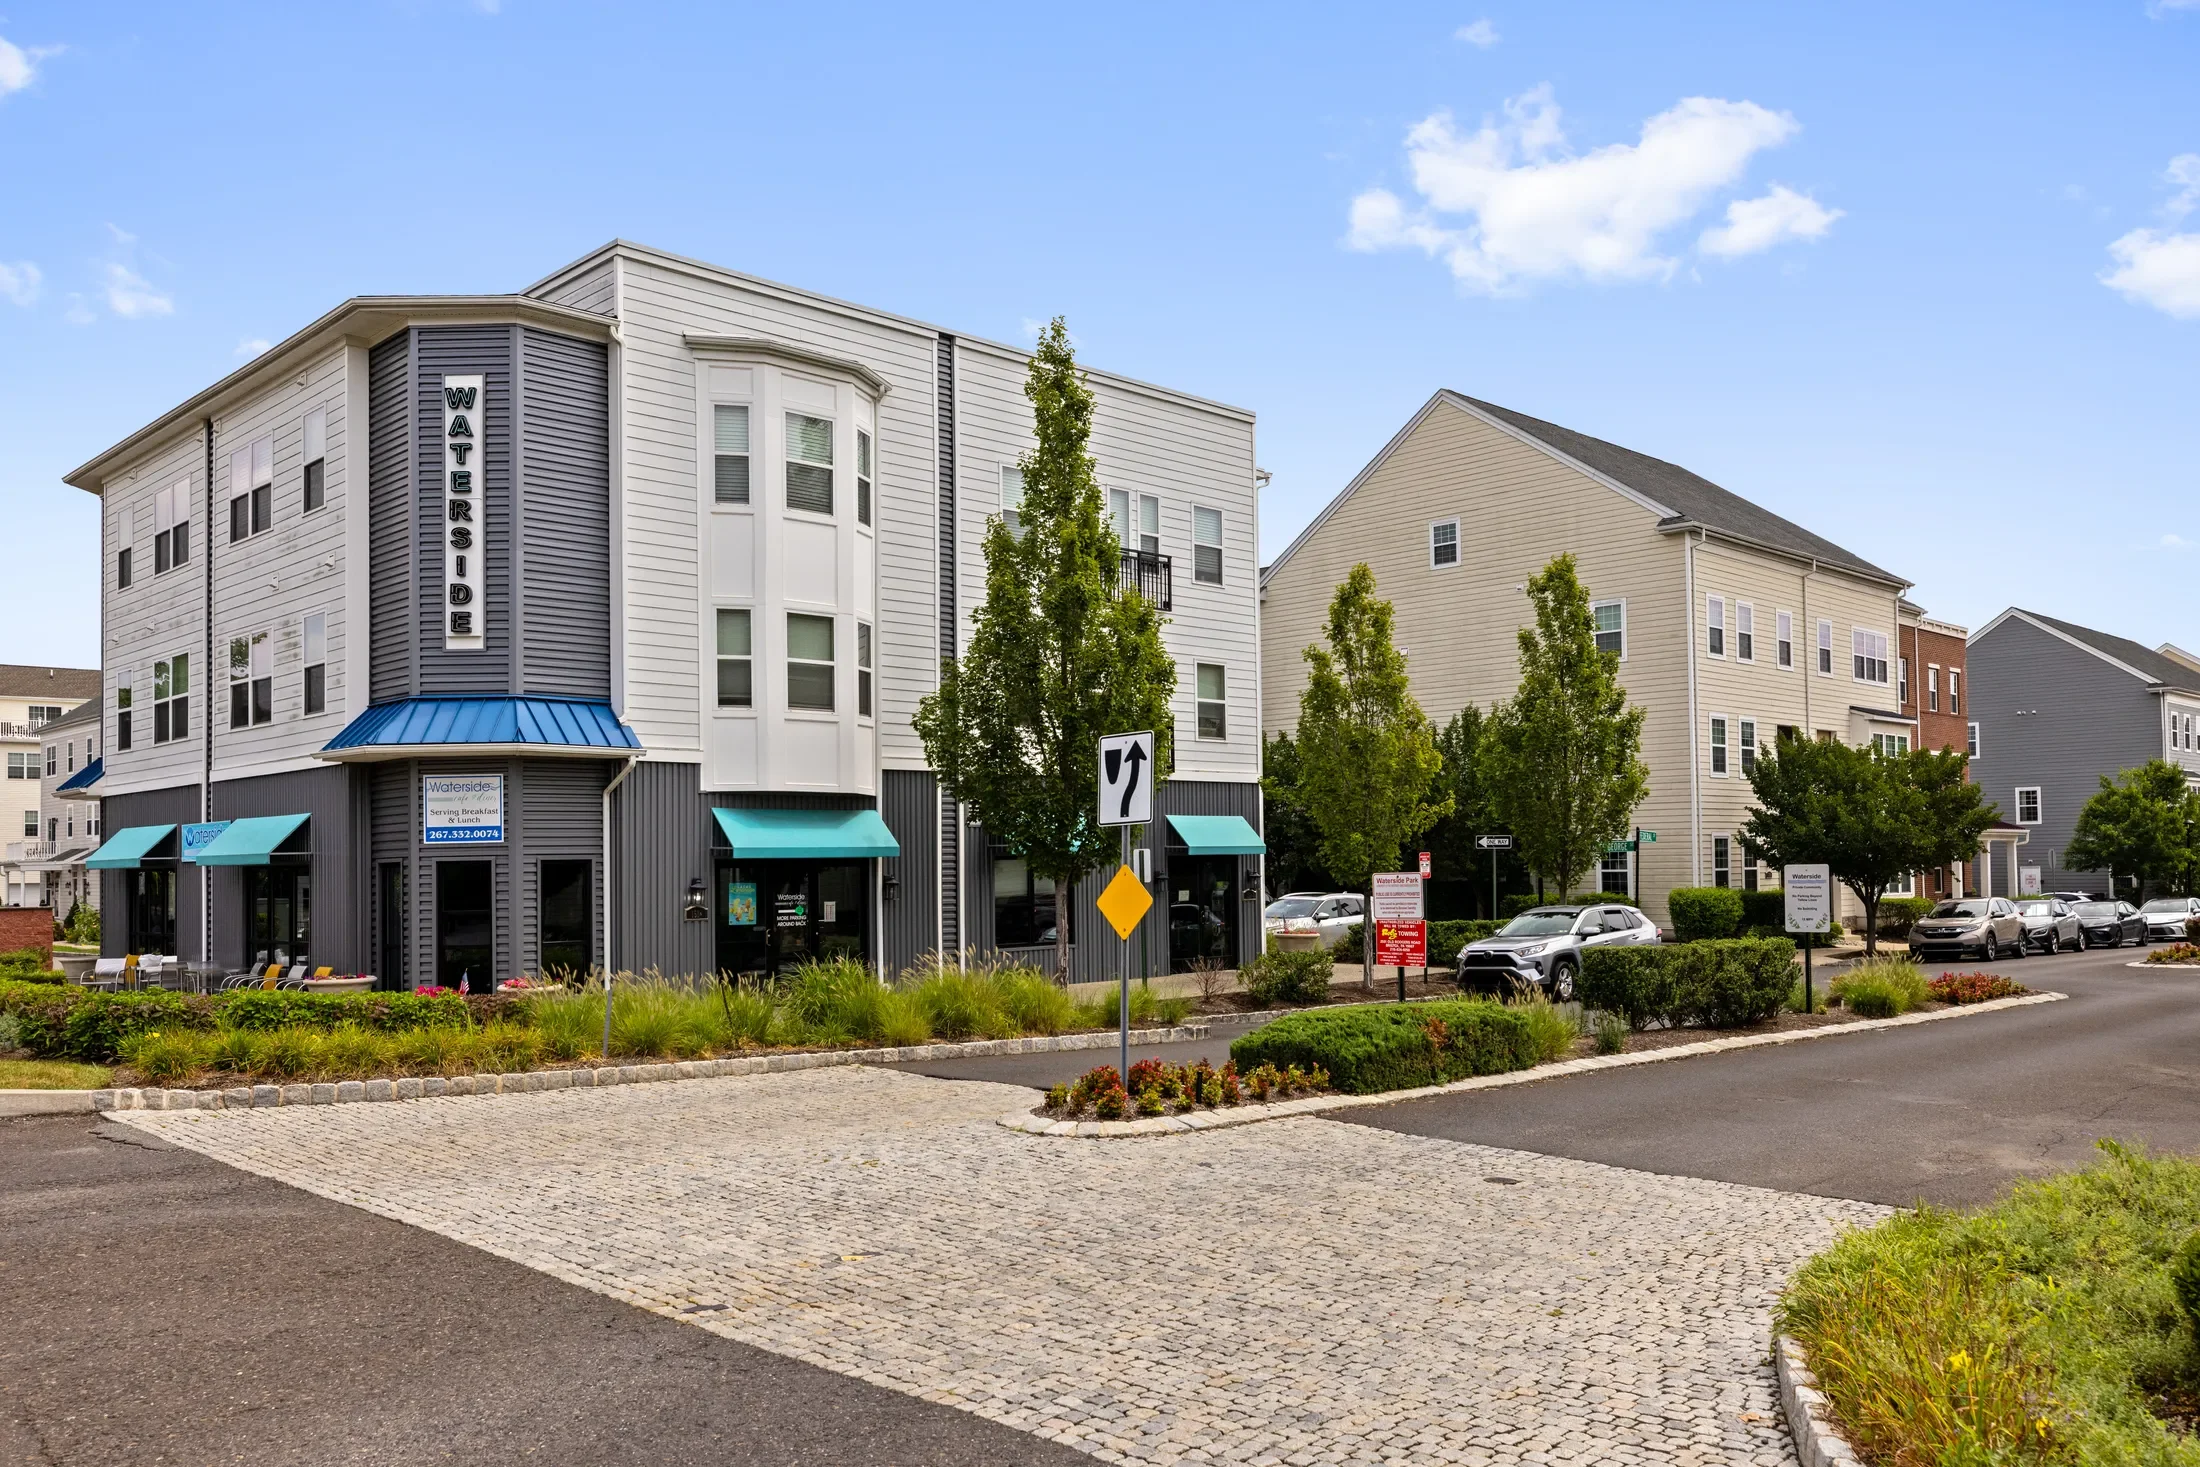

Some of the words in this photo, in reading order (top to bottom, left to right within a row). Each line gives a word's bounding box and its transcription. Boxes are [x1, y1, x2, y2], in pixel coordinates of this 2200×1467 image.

[445, 387, 477, 634] WATERSIDE
[429, 781, 491, 793] Waterside
[430, 808, 460, 818] Serving
[461, 807, 499, 815] Breakfast
[457, 816, 481, 824] Lunch
[186, 825, 225, 846] Watersid
[429, 829, 500, 839] 267.332.0074
[1608, 842, 1628, 851] GEORGE
